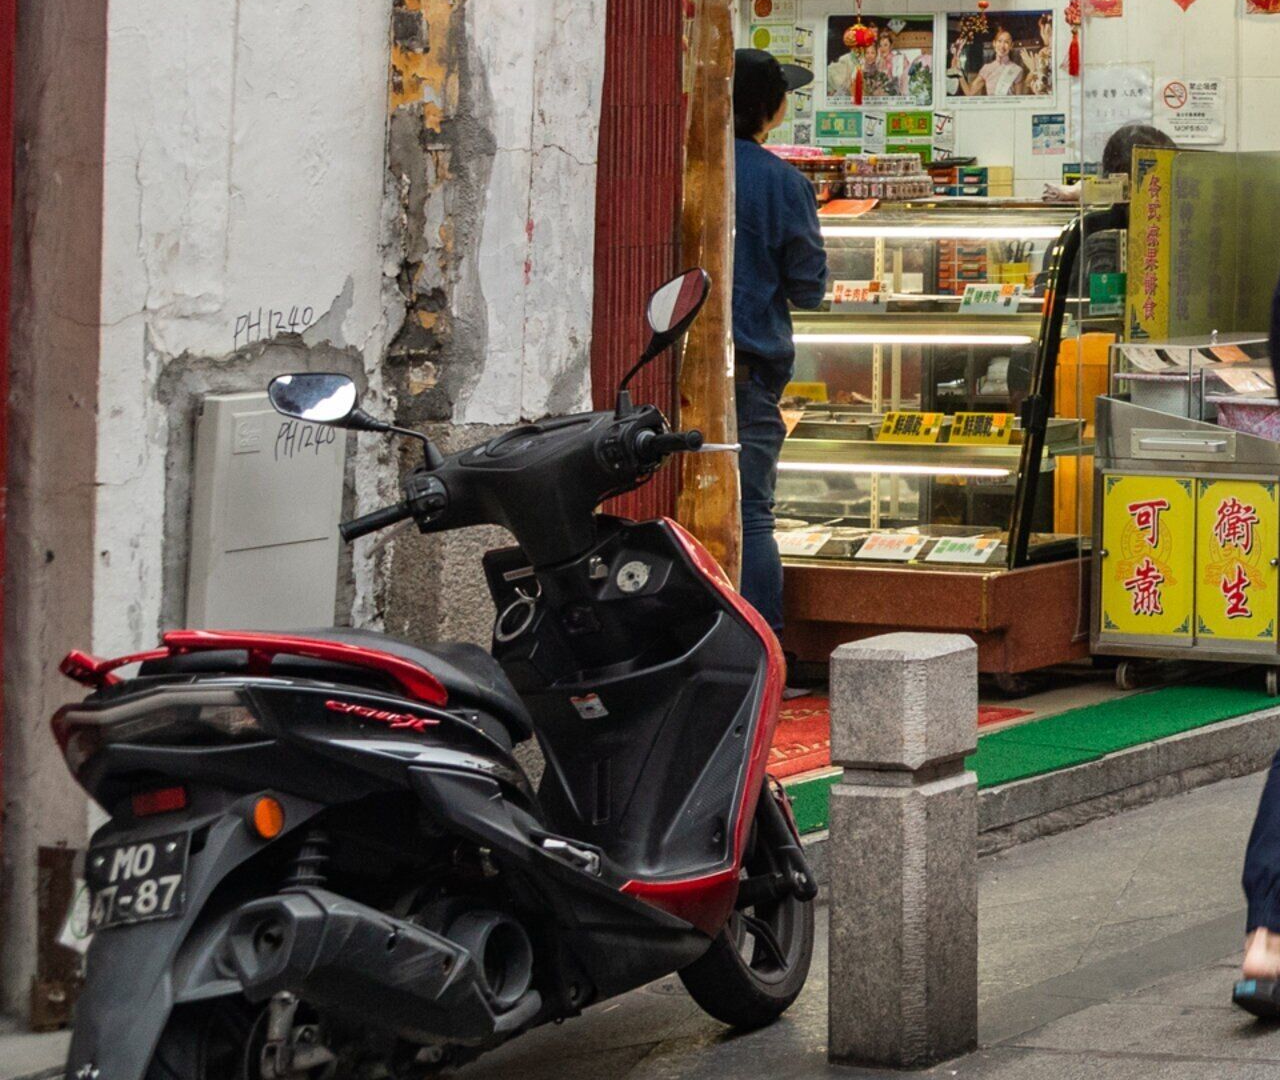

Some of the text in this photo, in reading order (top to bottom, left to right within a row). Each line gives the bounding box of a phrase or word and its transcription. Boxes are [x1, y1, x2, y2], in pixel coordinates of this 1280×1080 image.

[233, 305, 314, 352] PH1240
[1125, 499, 1170, 616] 可靠
[1214, 497, 1259, 619] 衛生
[109, 843, 155, 882] MO
